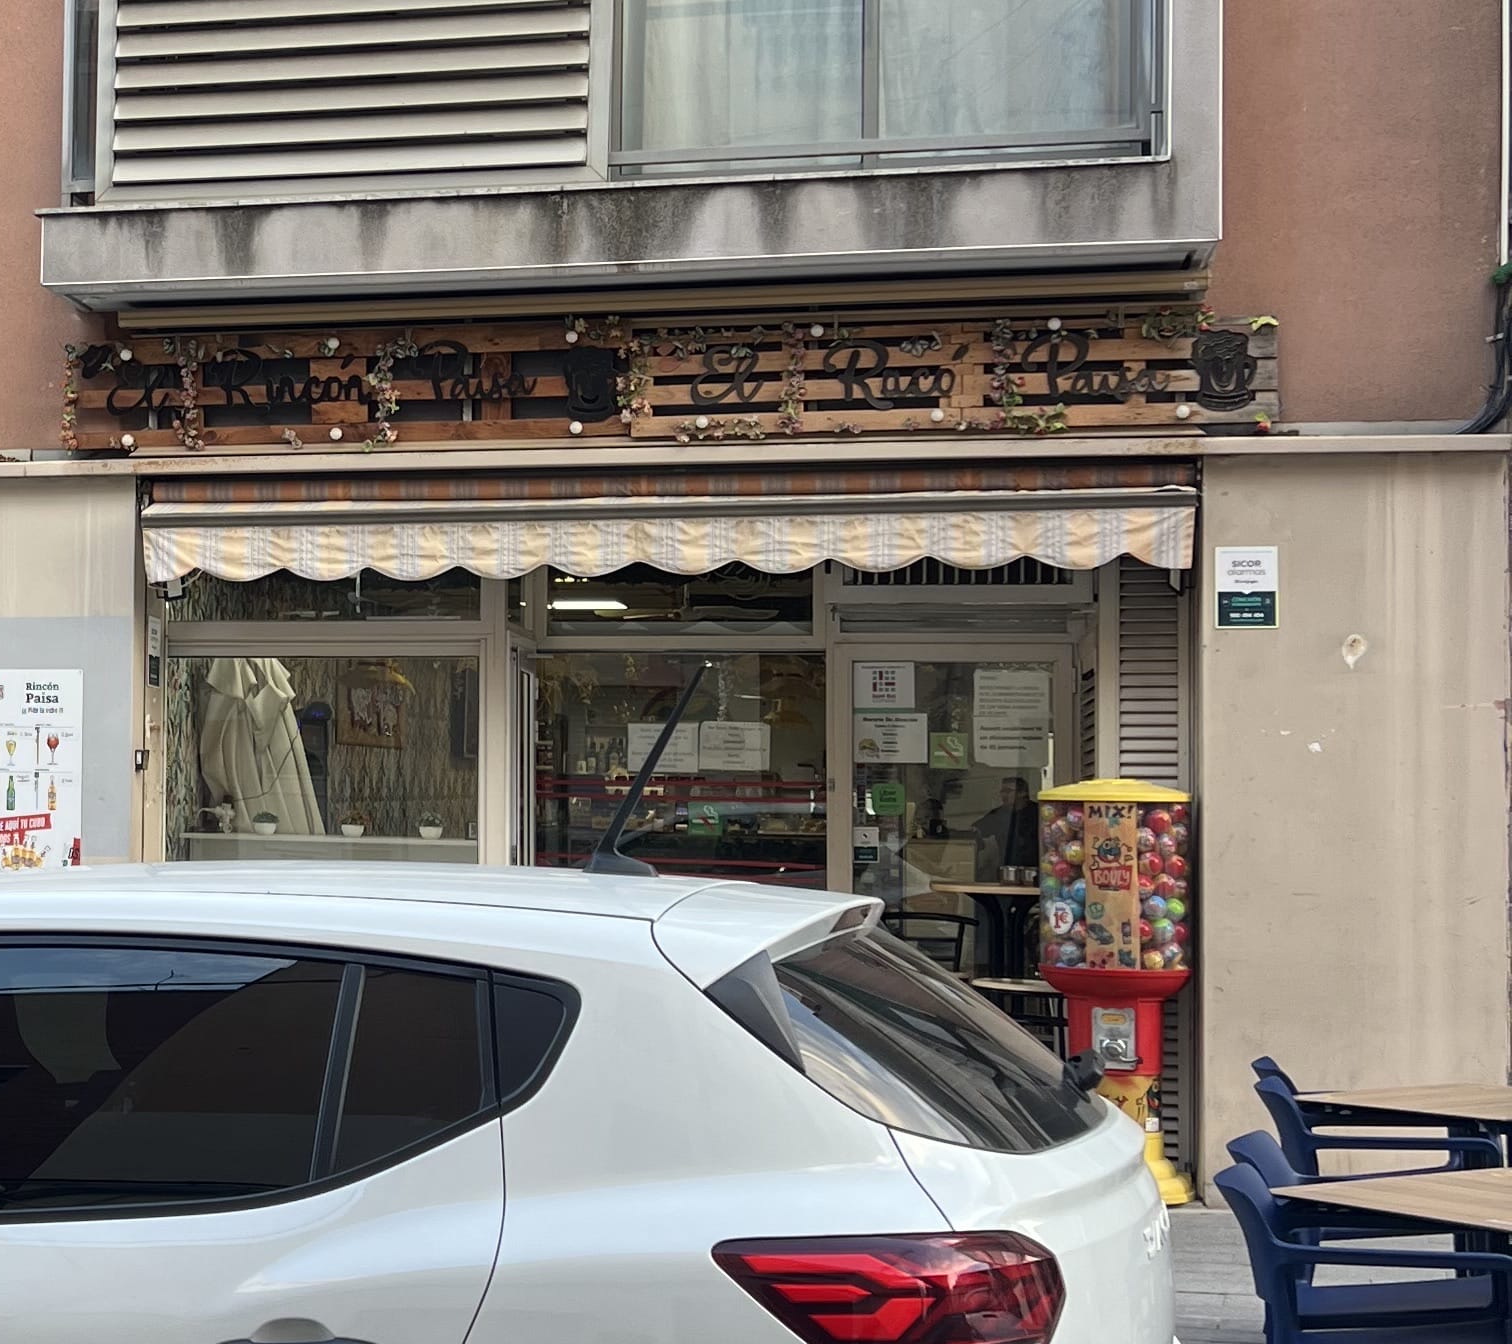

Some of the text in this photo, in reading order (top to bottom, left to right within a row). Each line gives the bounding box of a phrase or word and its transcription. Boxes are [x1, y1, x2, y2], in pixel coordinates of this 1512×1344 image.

[690, 332, 1171, 409] El Racó Paisa
[106, 339, 538, 417] El Rincón Paisa
[1231, 560, 1262, 569] SICOR
[25, 681, 59, 691] Rincón
[25, 692, 59, 704] Paisa
[1089, 805, 1134, 819] MIX!
